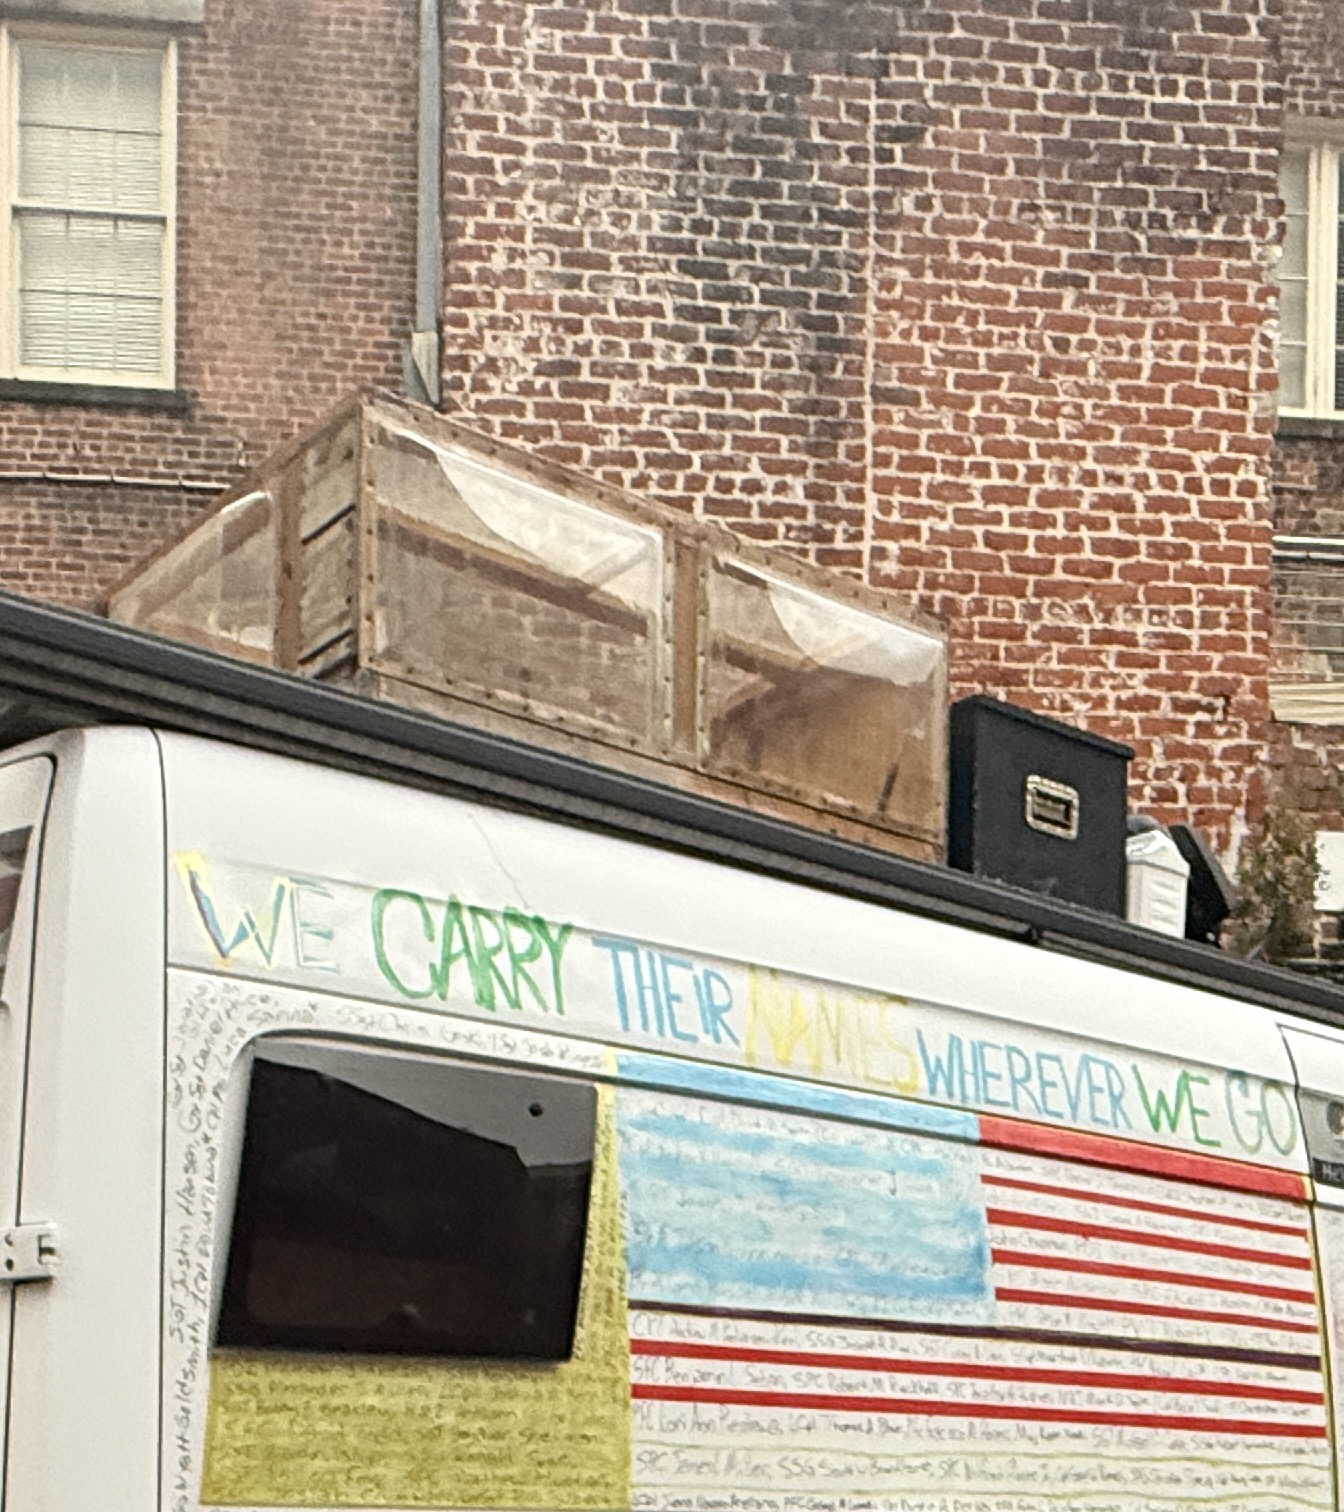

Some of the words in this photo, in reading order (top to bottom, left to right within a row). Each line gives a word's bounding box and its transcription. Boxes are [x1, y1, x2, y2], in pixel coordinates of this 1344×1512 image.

[175, 851, 340, 974] WE
[371, 888, 574, 1016] CARRY
[592, 937, 740, 1047] THEIR
[745, 962, 921, 1095] NAMES
[915, 1028, 1134, 1130] WHEREVER
[1131, 1064, 1222, 1148] WE
[1223, 1070, 1299, 1156] GO
